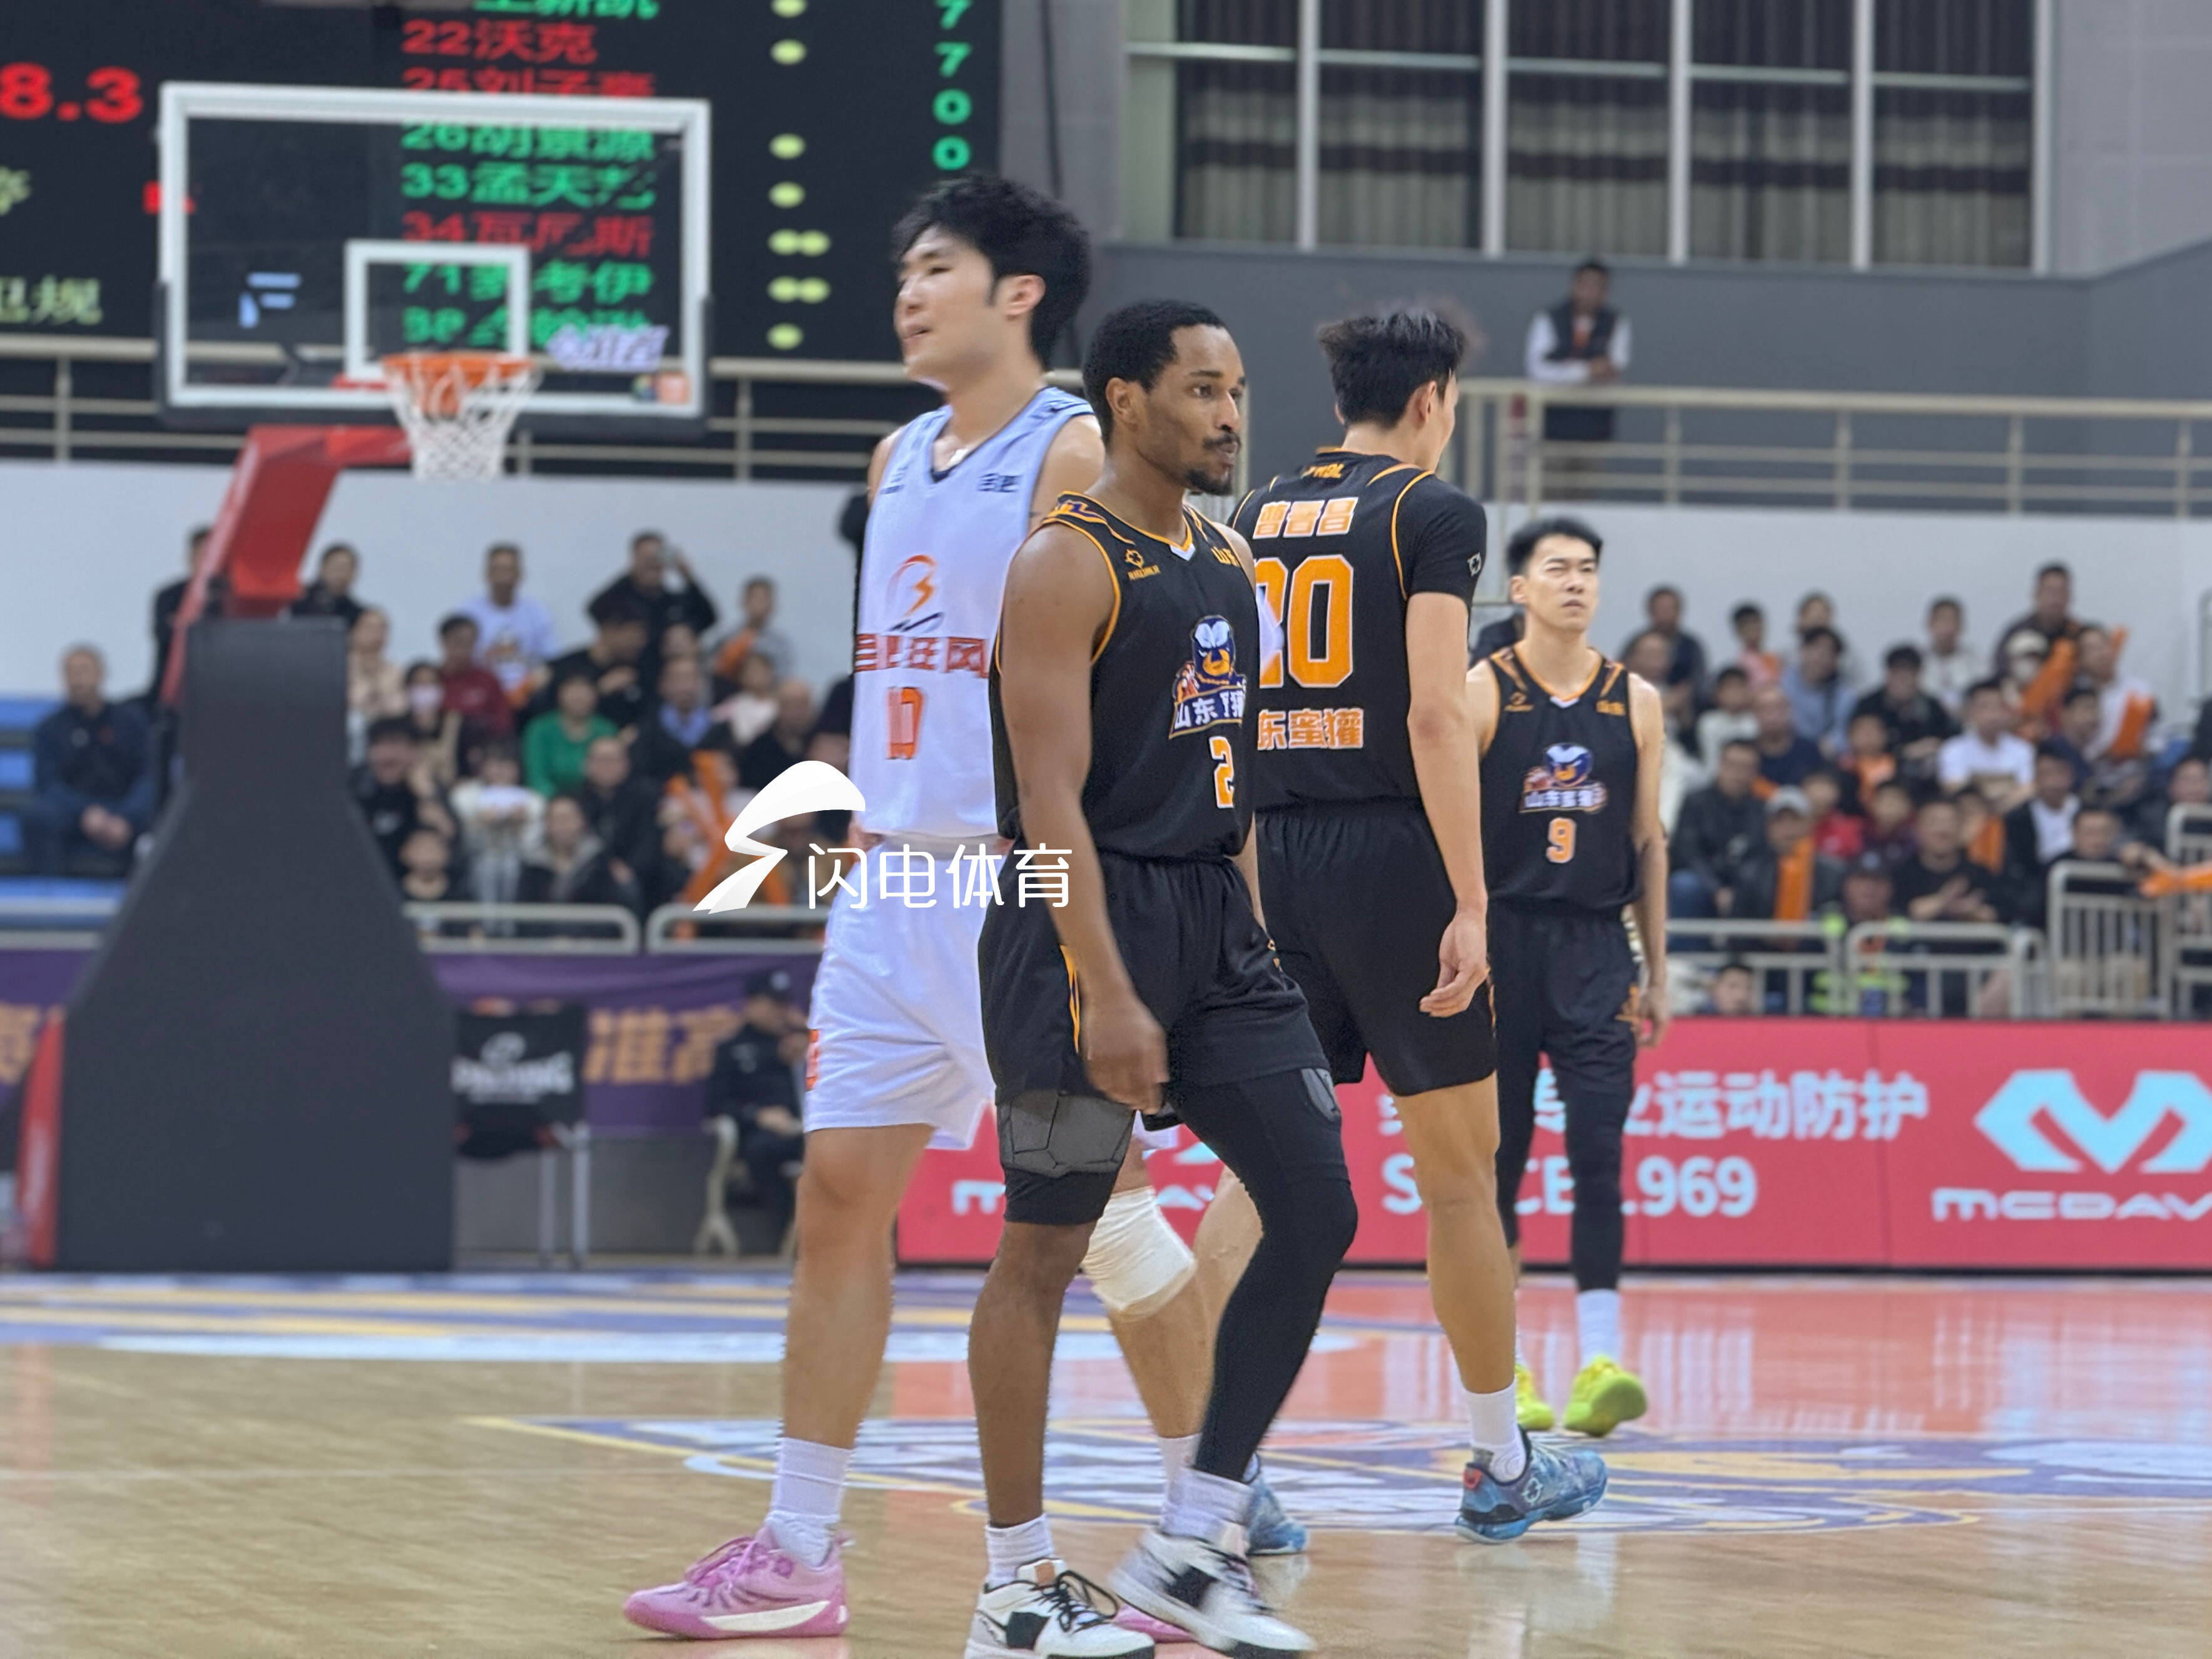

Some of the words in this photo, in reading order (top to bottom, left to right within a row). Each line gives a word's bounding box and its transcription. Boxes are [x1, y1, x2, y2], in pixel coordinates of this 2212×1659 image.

[935, 42, 972, 76] 7
[0, 61, 143, 123] 8.3
[932, 88, 972, 124] 0
[932, 135, 972, 170] 0
[1208, 736, 1235, 809] 2
[1546, 817, 1577, 864] 9
[1622, 1155, 1760, 1217] 969
